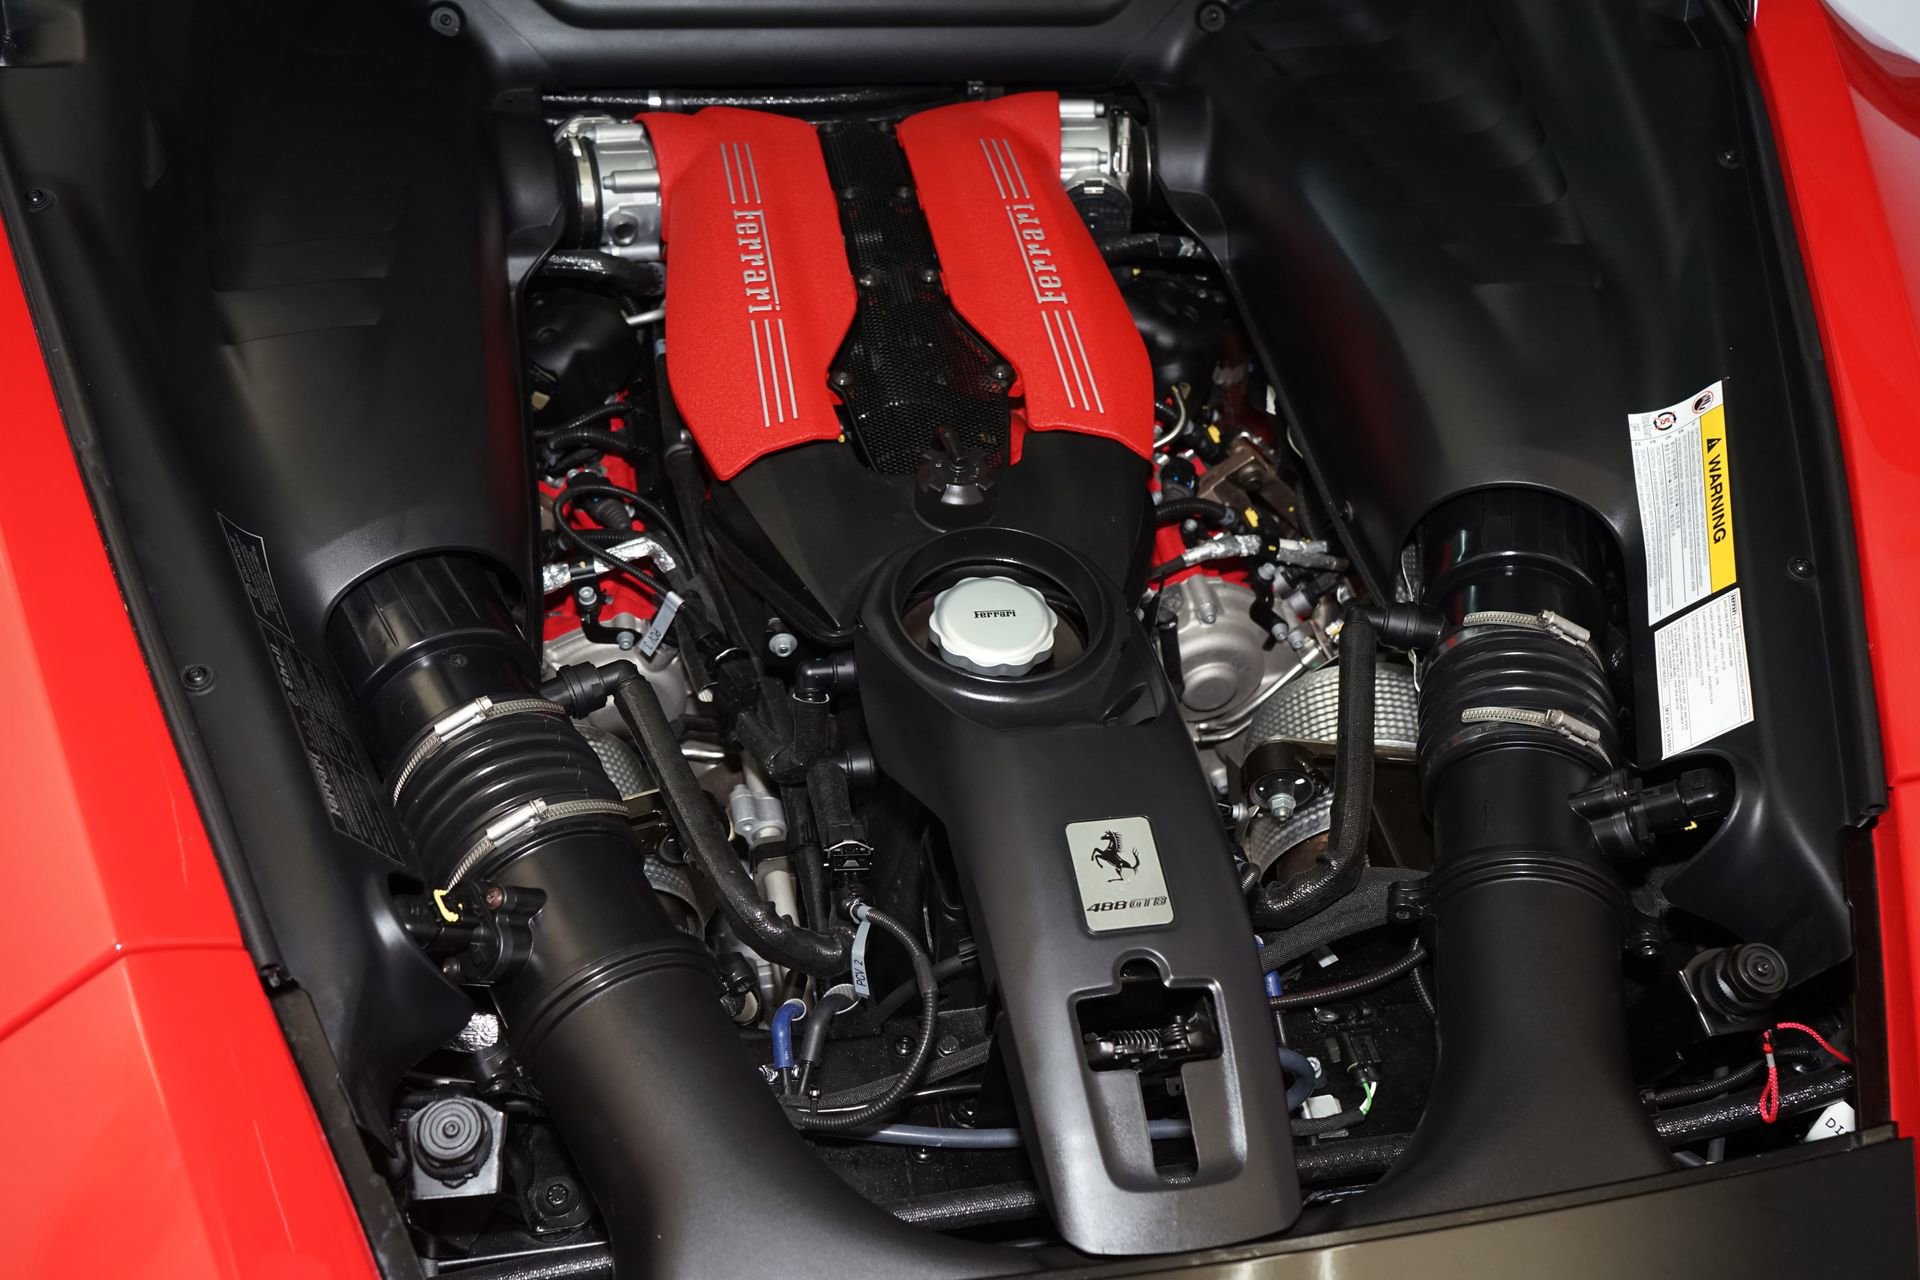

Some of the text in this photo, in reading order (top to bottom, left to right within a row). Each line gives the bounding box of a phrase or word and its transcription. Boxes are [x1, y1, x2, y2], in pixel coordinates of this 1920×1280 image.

[733, 209, 781, 313] Ferrari
[1005, 203, 1069, 305] Ferrari
[1708, 454, 1727, 544] WARNING
[974, 609, 1017, 619] Ferrari
[270, 643, 293, 690] Shell
[309, 750, 343, 818] Ferrari
[1087, 896, 1167, 912] 488 GTB
[855, 968, 866, 986] PCV
